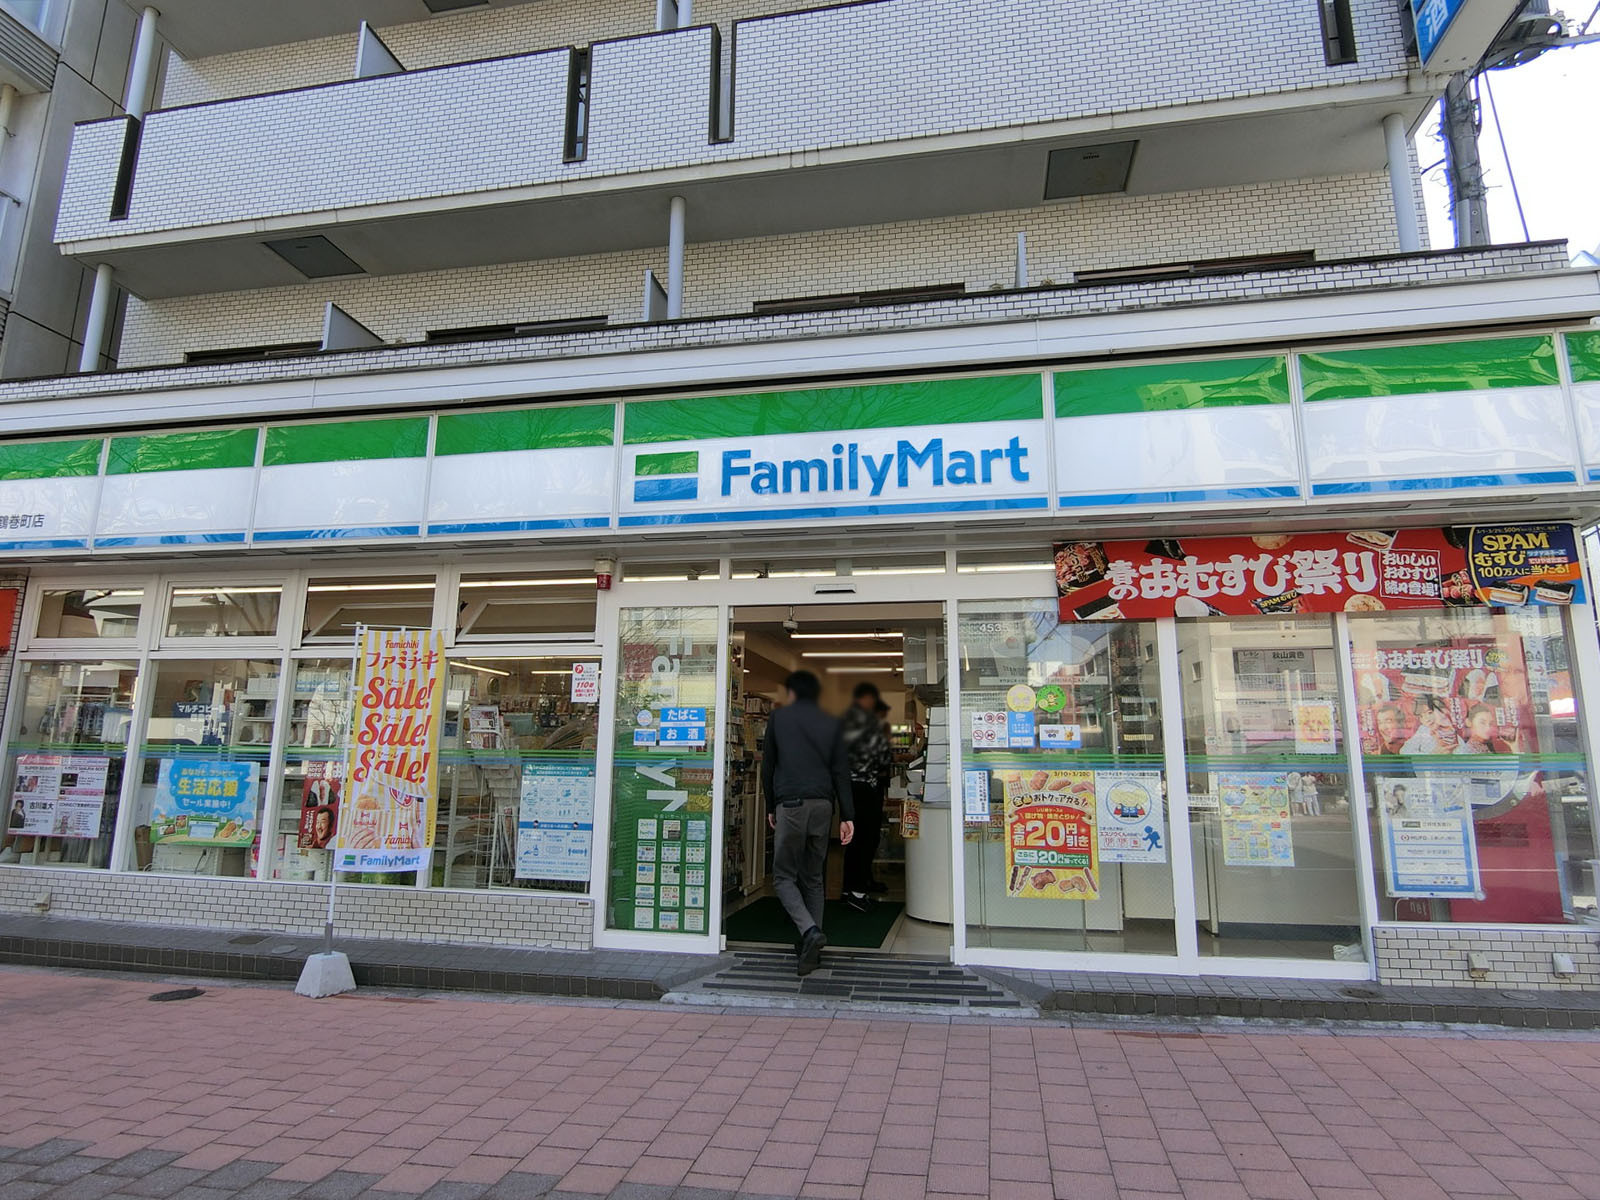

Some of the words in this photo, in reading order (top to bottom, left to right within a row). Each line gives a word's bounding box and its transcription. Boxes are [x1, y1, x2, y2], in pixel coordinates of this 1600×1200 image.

[721, 436, 1030, 497] FamilyMart
[1482, 532, 1550, 551] SPAM
[1382, 552, 1436, 566] おいしい
[1474, 550, 1526, 567] むすび
[1104, 548, 1378, 601] 春のおむすび祭り
[1384, 566, 1438, 581] おむすび
[1478, 564, 1570, 578] 100万人に当たる!
[385, 640, 419, 649] Famichiki
[366, 650, 440, 671] ファミチキ
[361, 676, 437, 710] Sale!
[667, 709, 699, 721] たばこ
[357, 712, 433, 747] Sale!
[665, 727, 699, 740] お酒
[177, 778, 239, 797] 生活応援
[360, 854, 421, 868] FamilyMart
